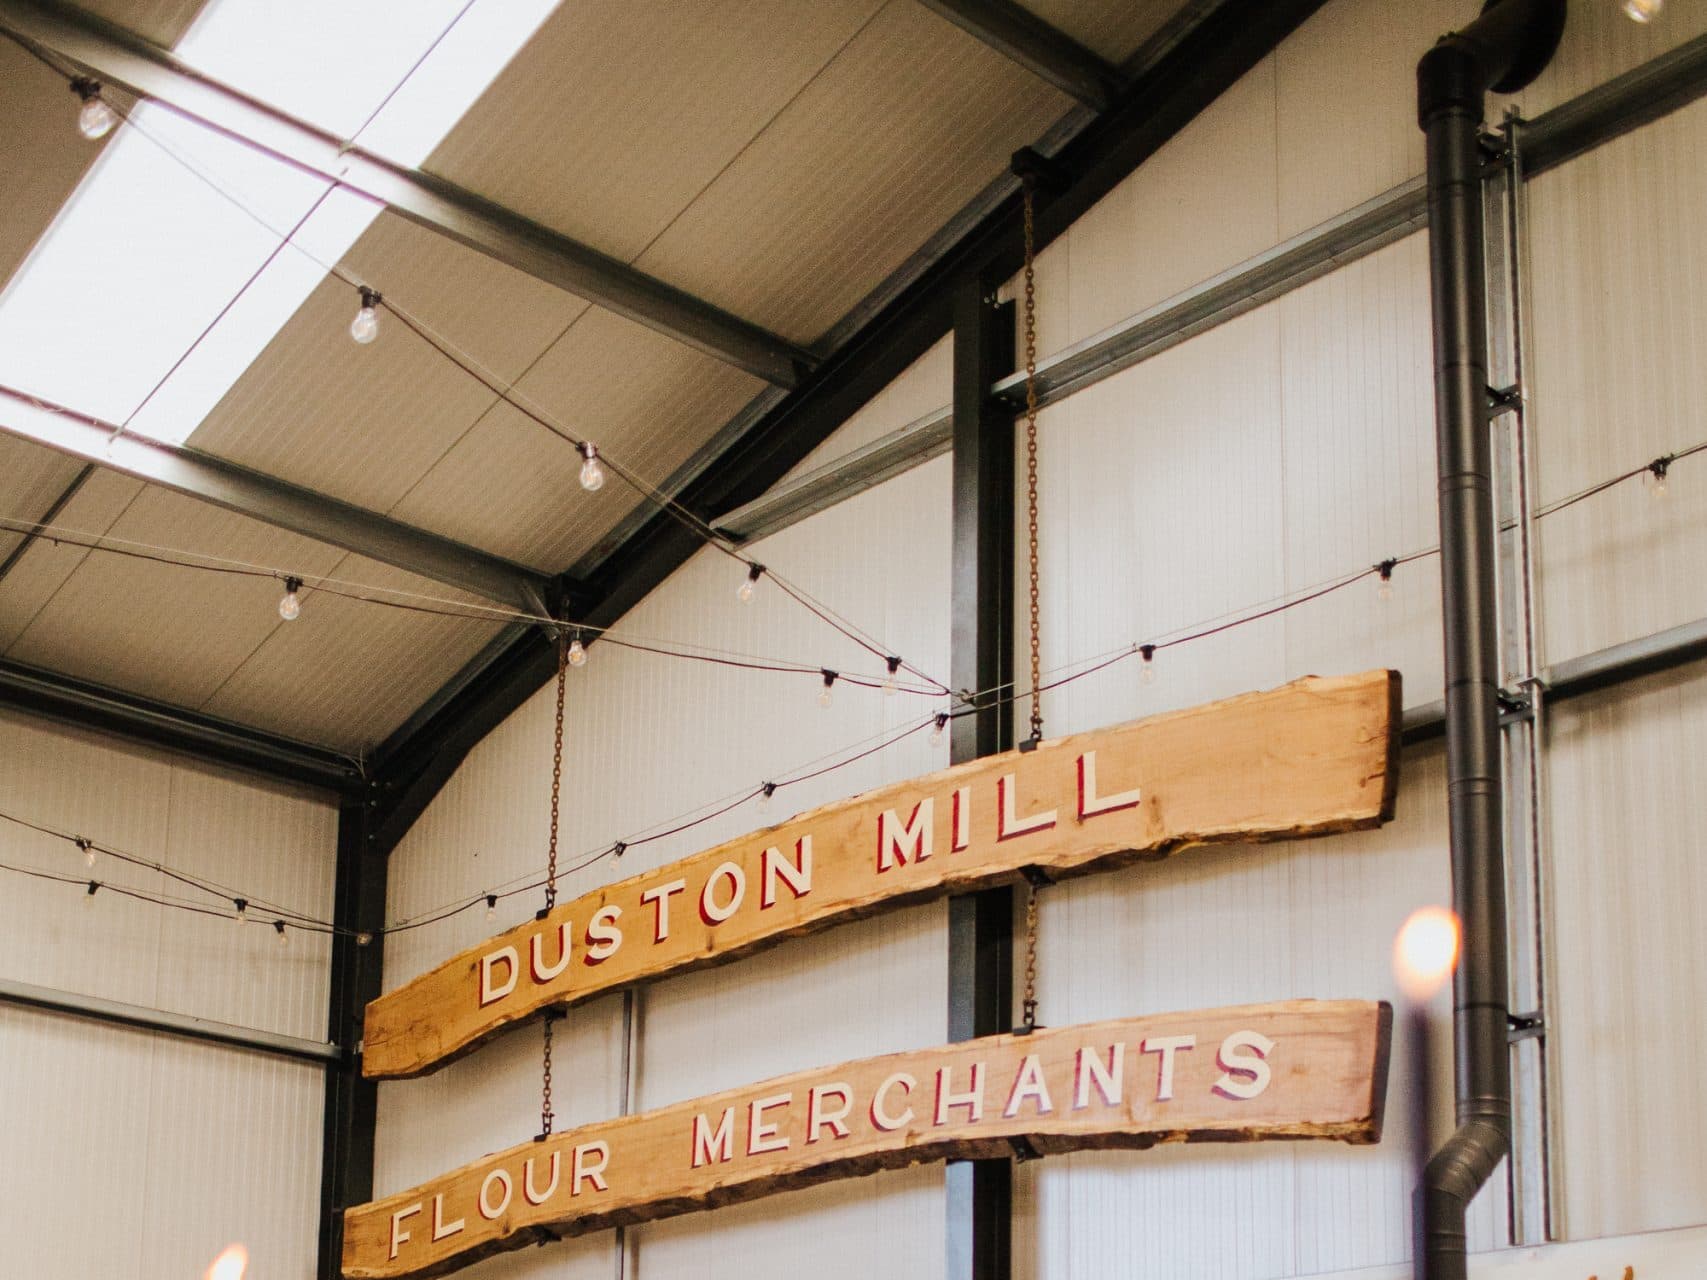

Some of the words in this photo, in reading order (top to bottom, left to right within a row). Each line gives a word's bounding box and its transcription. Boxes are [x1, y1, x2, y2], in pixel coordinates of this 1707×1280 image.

[478, 834, 813, 1006] DUSTON
[876, 750, 1141, 874] MILL
[388, 1139, 611, 1260] FLOUR
[691, 1030, 1277, 1168] MERCHANTS
